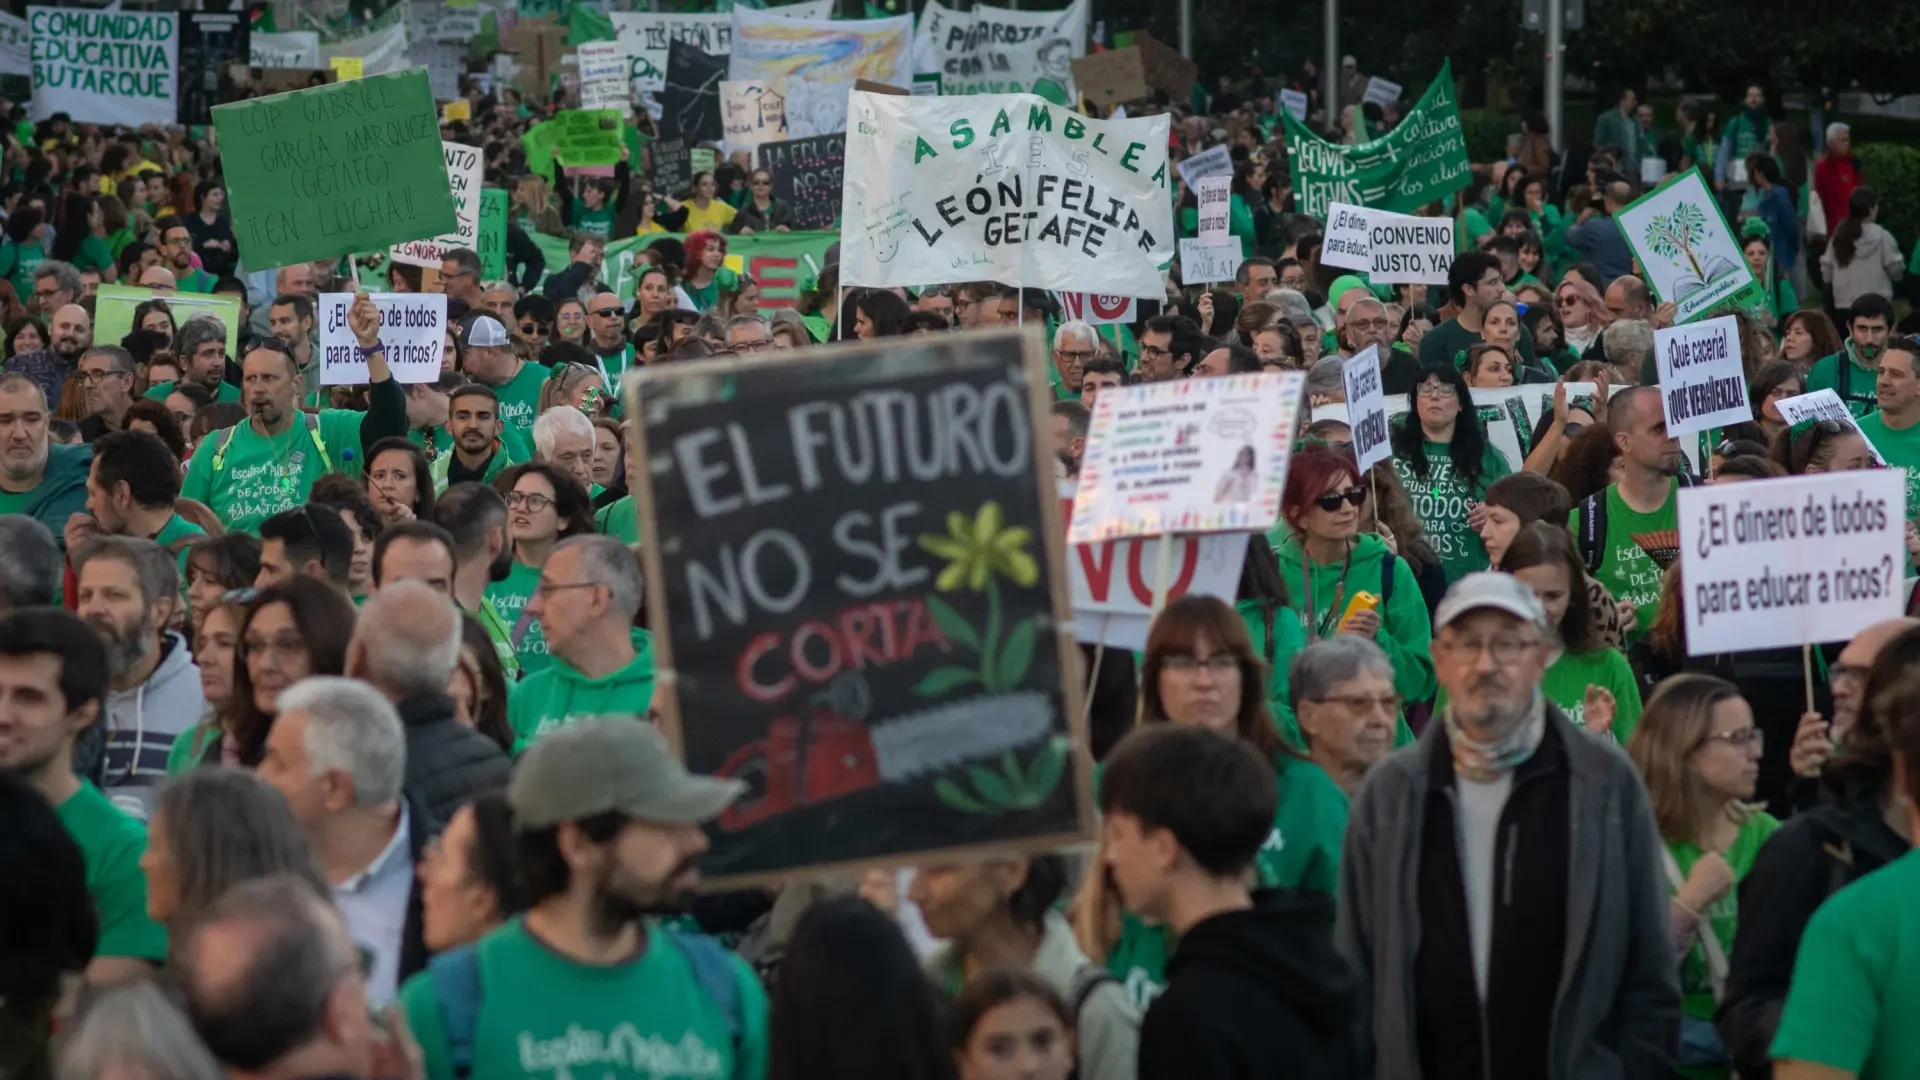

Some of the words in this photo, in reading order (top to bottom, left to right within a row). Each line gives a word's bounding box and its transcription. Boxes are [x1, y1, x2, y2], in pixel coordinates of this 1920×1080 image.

[31, 11, 173, 41] COMUNIDAD
[31, 37, 169, 70] EDUCATIVA
[33, 63, 171, 99] BUTARQUE
[302, 85, 395, 123] GABRIEL
[260, 134, 331, 172] GARCÍA
[345, 111, 432, 154] MÁRQUEZ
[914, 103, 1166, 190] ASAMBLEA
[911, 173, 1023, 248] LEÓN
[1332, 211, 1347, 230] ¿El
[984, 212, 1108, 259] GETAFE
[1326, 239, 1346, 254] para
[1369, 227, 1452, 250] ¡CONVENIO
[1371, 254, 1426, 275] JUSTO,
[328, 303, 346, 333] ¿El
[388, 303, 402, 327] de
[405, 304, 437, 328] todos
[326, 344, 351, 370] para
[403, 340, 438, 364] ricos?
[1667, 334, 1690, 378] ¡Qué
[1693, 327, 1728, 362] cacería!
[1668, 382, 1688, 426] ¡QUÉ
[1688, 375, 1745, 418] VERGÜENZA!
[673, 423, 792, 518] EL
[789, 381, 1031, 492] FUTURO
[237, 487, 252, 498] DE
[1697, 502, 1729, 560] ¿El
[1733, 501, 1798, 544] dinero
[1802, 491, 1827, 537] de
[1830, 488, 1887, 535] todos
[686, 527, 813, 641] NO
[833, 501, 931, 597] SE
[1695, 579, 1741, 628] para
[1746, 565, 1812, 610] educar
[1817, 570, 1830, 604] a
[1834, 553, 1894, 602] ricos?
[735, 595, 951, 702] CORTA
